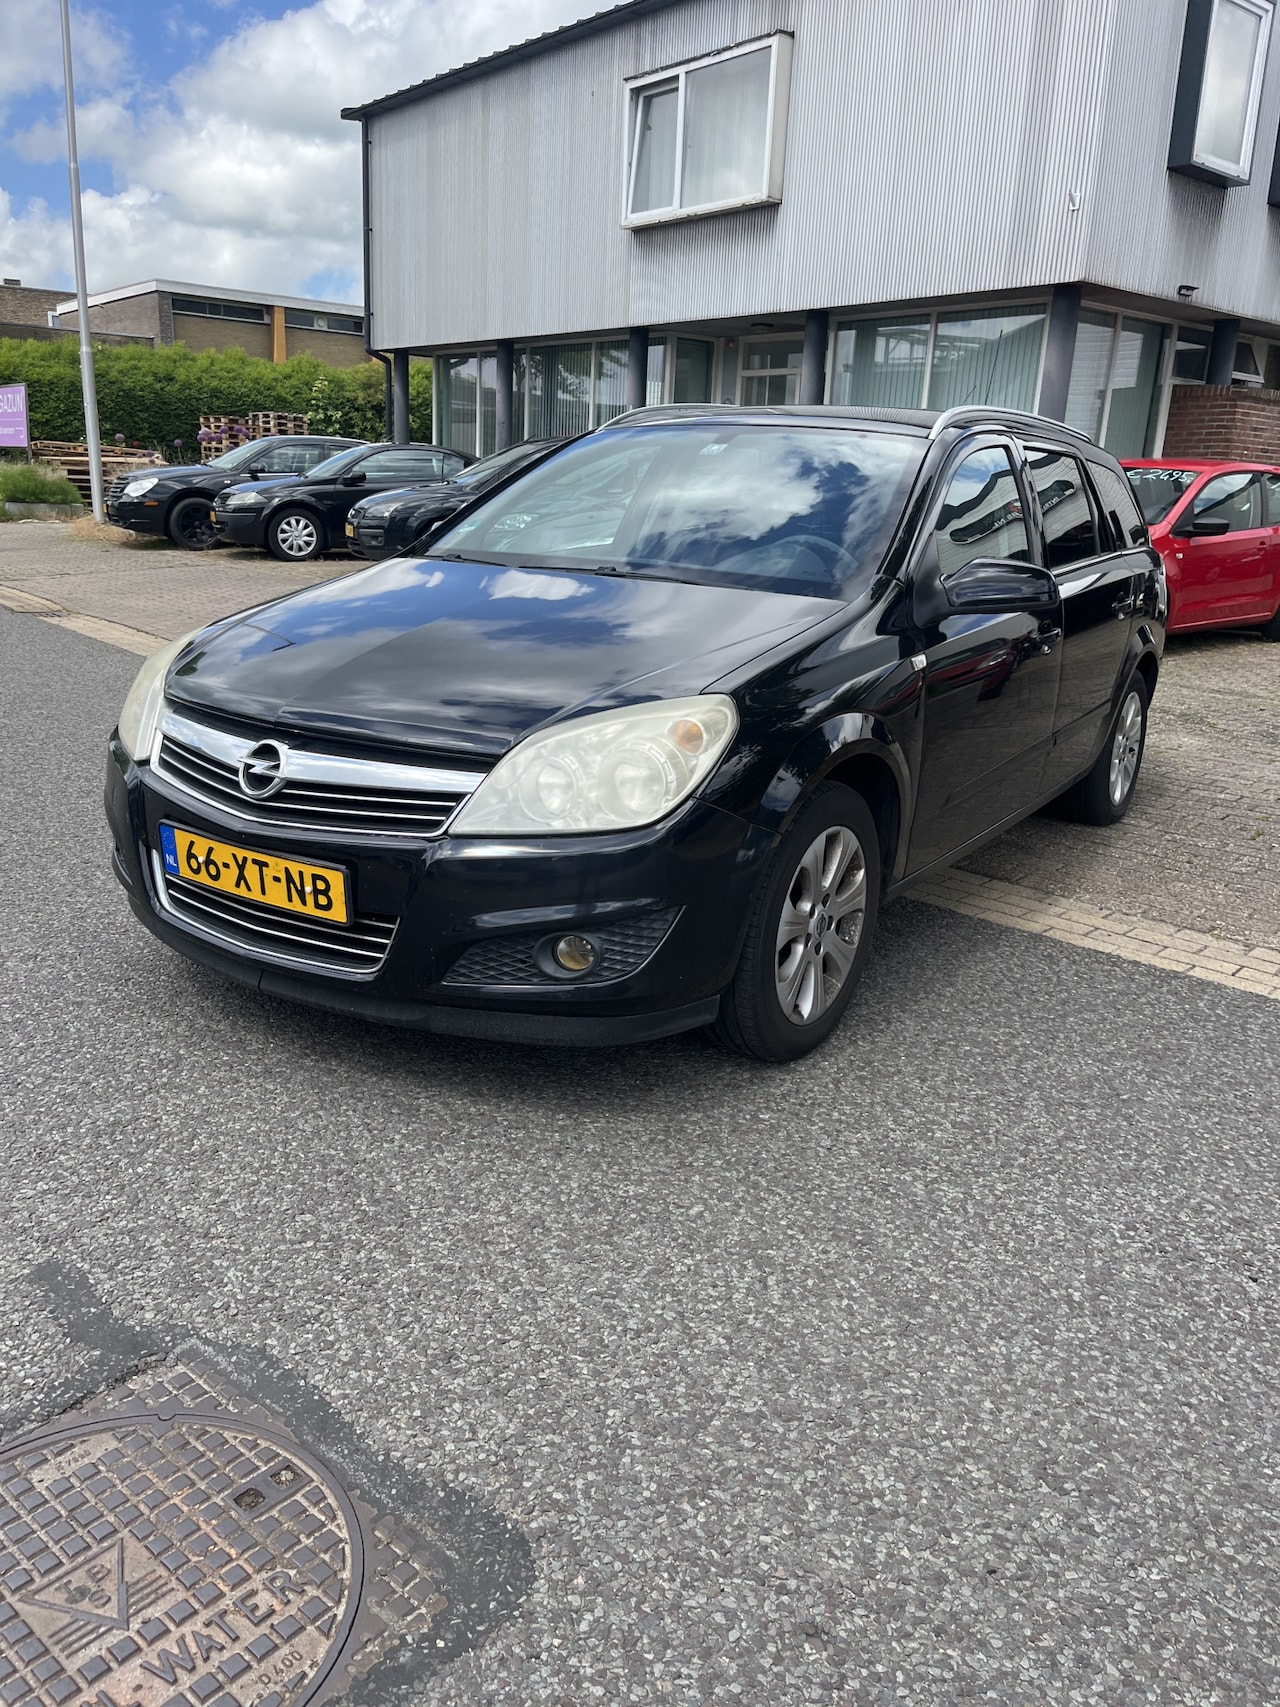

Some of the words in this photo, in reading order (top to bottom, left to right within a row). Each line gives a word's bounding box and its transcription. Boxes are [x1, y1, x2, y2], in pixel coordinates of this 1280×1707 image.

[165, 853, 178, 867] NL
[186, 840, 333, 911] 66-XT-NB
[140, 1570, 304, 1686] WATER
